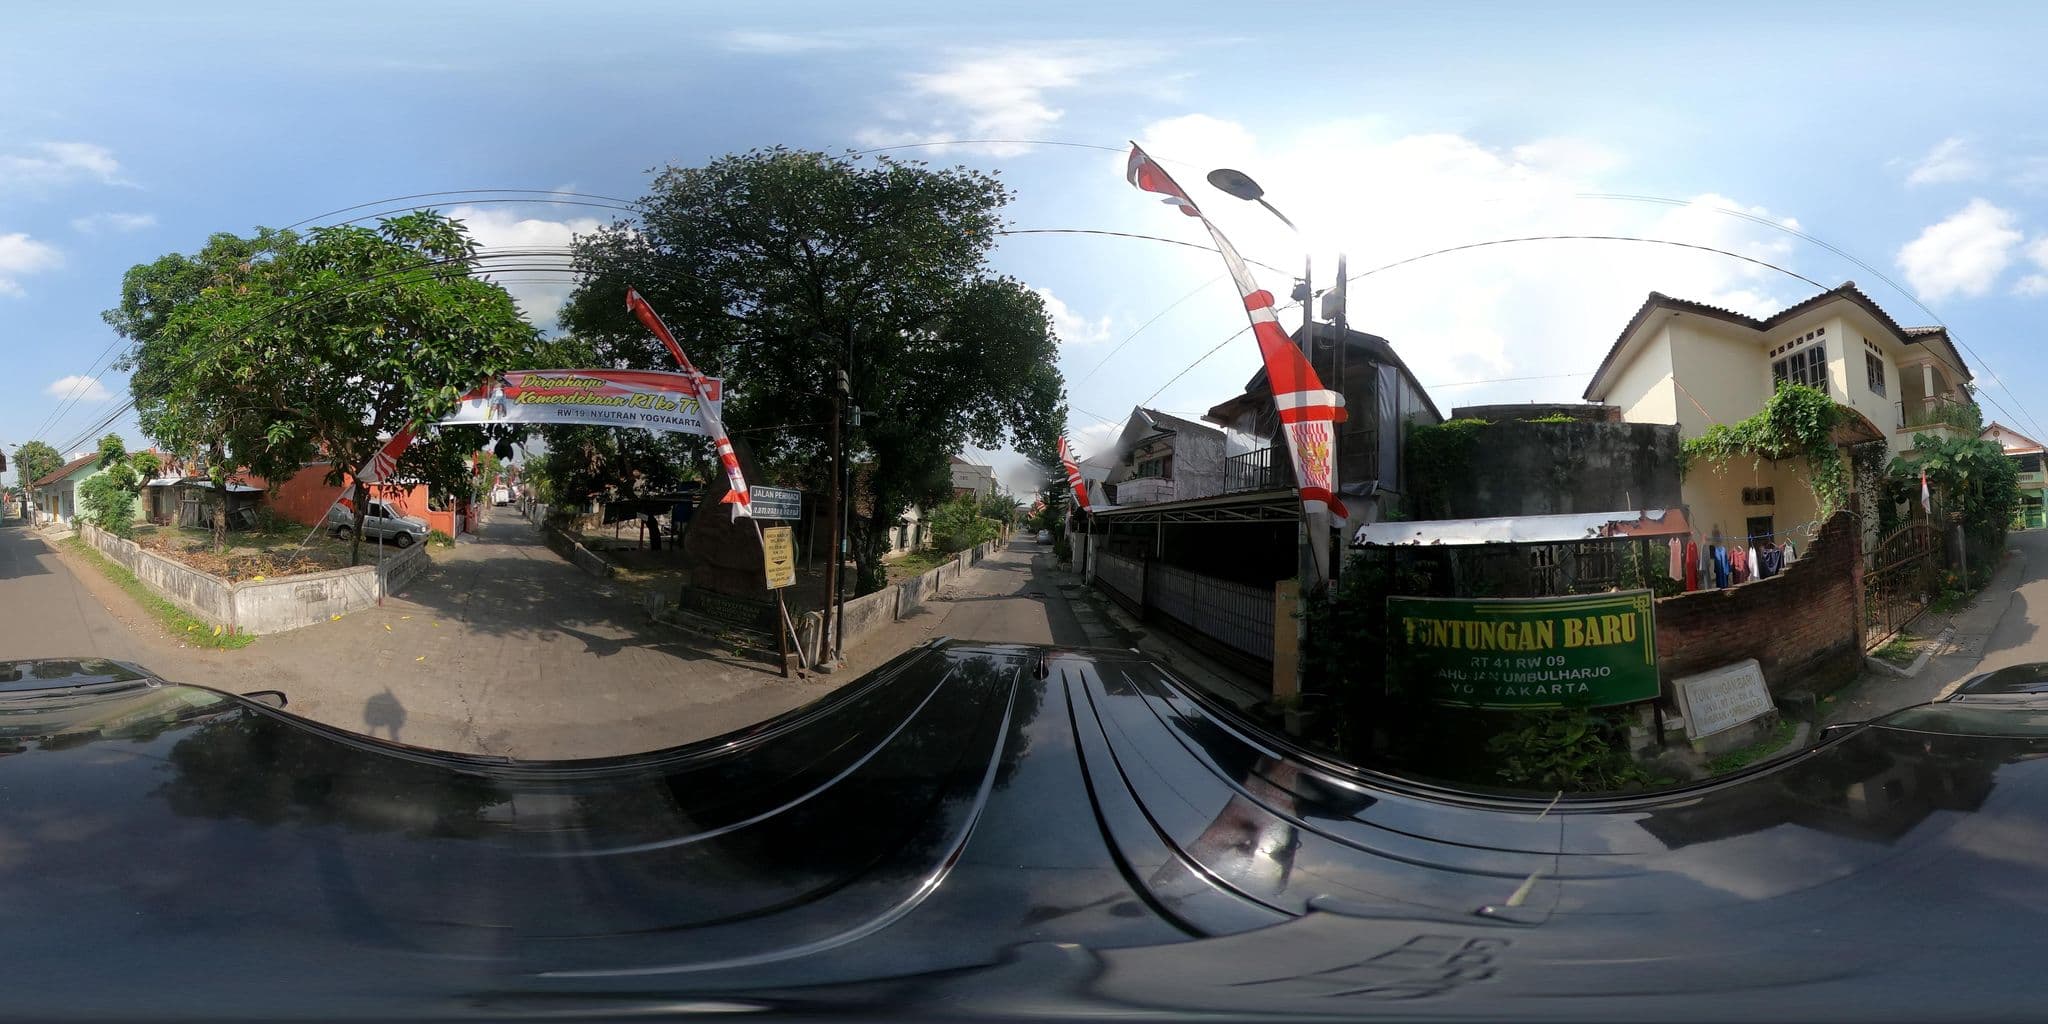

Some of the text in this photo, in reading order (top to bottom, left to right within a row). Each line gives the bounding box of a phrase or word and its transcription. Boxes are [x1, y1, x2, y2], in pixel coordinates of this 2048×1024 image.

[521, 374, 604, 391] Dirgahayu
[514, 391, 628, 408] Kemerdekaan
[629, 393, 655, 409] RI
[654, 397, 676, 412] ke
[557, 409, 701, 428] RW 19 NYUTRAN YOGYAKARTA
[753, 489, 774, 499] JALAN
[1562, 612, 1637, 649] BARU
[1470, 655, 1566, 670] RT 41 RW 09
[1502, 666, 1612, 683] UMBULHARJO
[1451, 682, 1590, 697] YOYAKARTA
